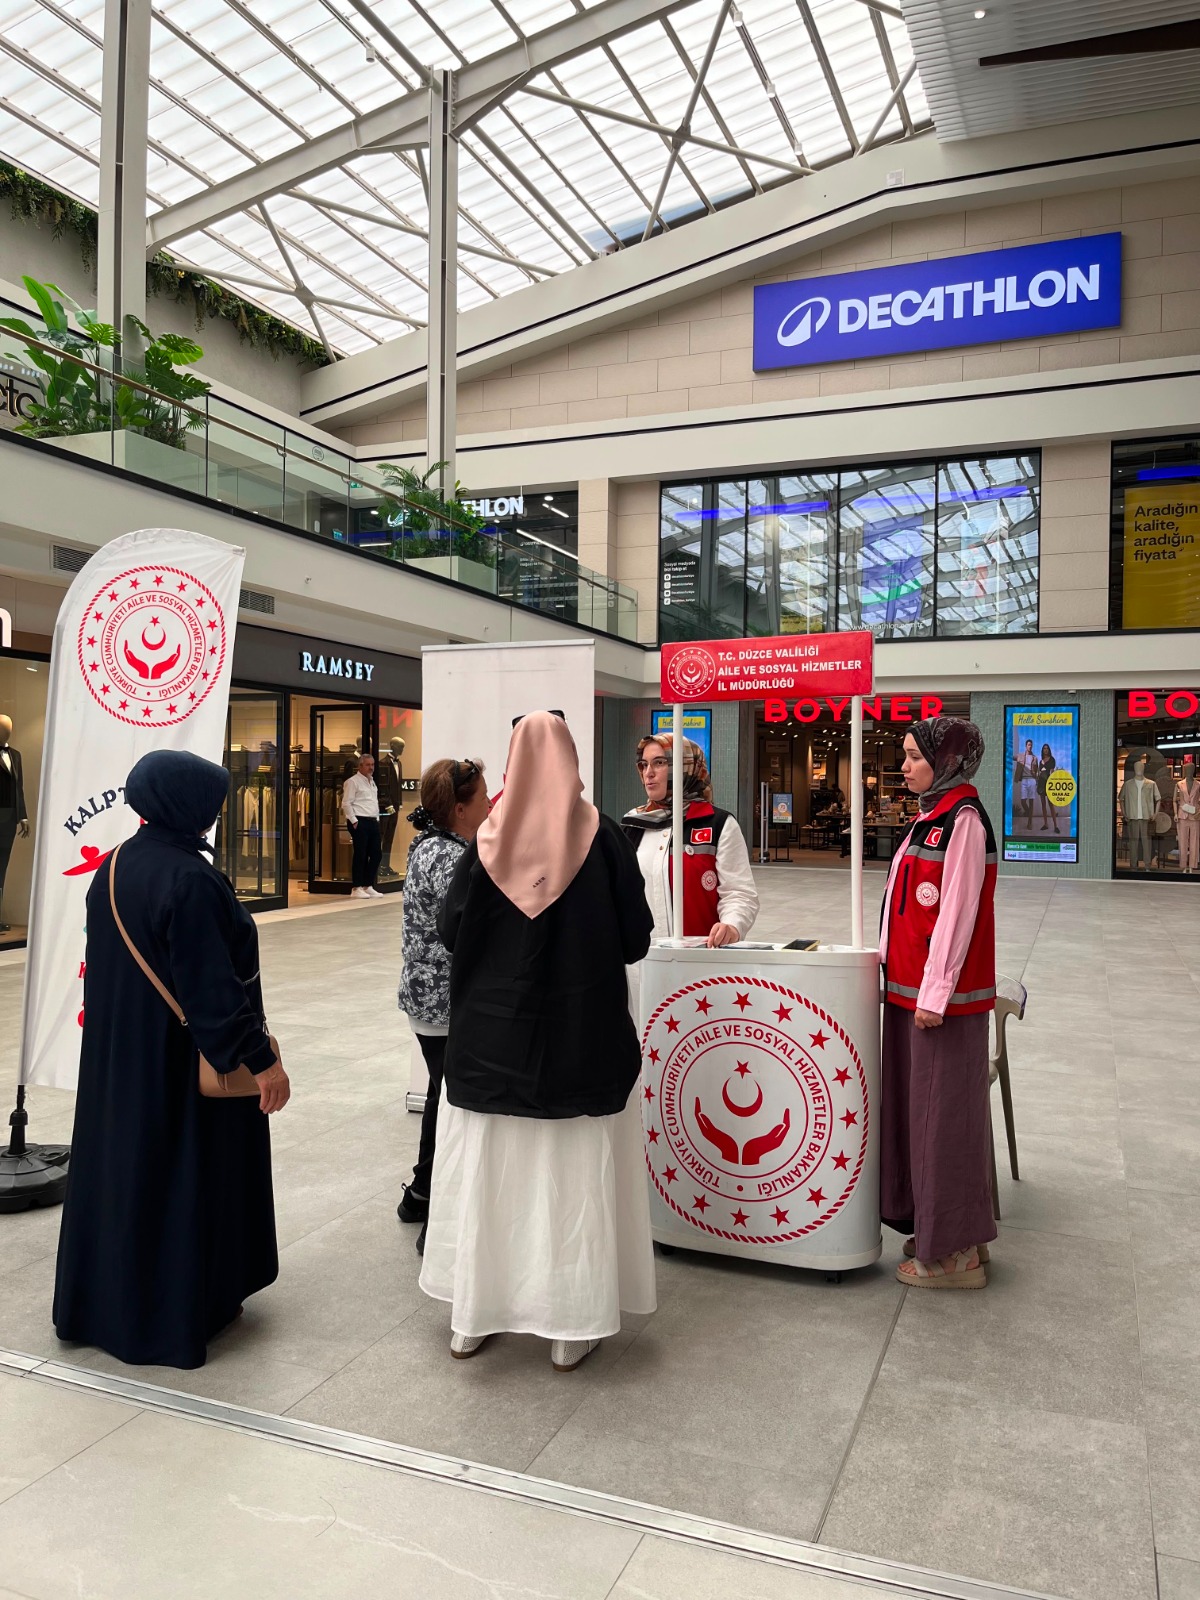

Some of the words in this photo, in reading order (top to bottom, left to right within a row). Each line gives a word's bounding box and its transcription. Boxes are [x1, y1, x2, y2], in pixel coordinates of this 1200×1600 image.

[838, 264, 1100, 334] DECATHLON
[1134, 503, 1198, 518] Aradığın
[1134, 520, 1179, 532] kalite,
[1133, 533, 1195, 547] aradığın
[1133, 549, 1177, 563] fiyata
[127, 596, 145, 610] AİLE
[145, 594, 157, 603] VE
[158, 595, 187, 616] SOSYAL
[104, 605, 128, 665] CUMHURİYETİ
[186, 613, 203, 664] HİZMETLER
[718, 652, 736, 661] T.C.
[738, 649, 773, 660] DÜZCE
[775, 645, 819, 659] VALİLİĞİ
[302, 652, 375, 681] RAMSEY
[718, 664, 740, 676] AİLE
[743, 665, 758, 675] VE
[759, 663, 799, 674] SOSYAL
[801, 660, 862, 672] HİZMETLER
[109, 666, 137, 696] TÜRKİYE
[158, 663, 199, 699] BAKANLIĞI
[718, 681, 728, 691] İL
[730, 678, 795, 691] MÜDÜRLÜĞÜ
[764, 696, 944, 722] BOYNER
[1128, 691, 1199, 719] BO
[1018, 714, 1035, 724] Hello
[1035, 714, 1068, 725] Sunshine
[1048, 782, 1074, 791] 2.000
[694, 1026, 722, 1049] AİLE
[723, 1024, 741, 1037] VE
[744, 1025, 794, 1061] SOSYAL
[665, 1039, 695, 1137] CUMHURİYETİ
[793, 1057, 827, 1141] HİZMETLER
[674, 1138, 721, 1189] TÜRKİYE
[757, 1141, 822, 1197] BAKANLIĞI
